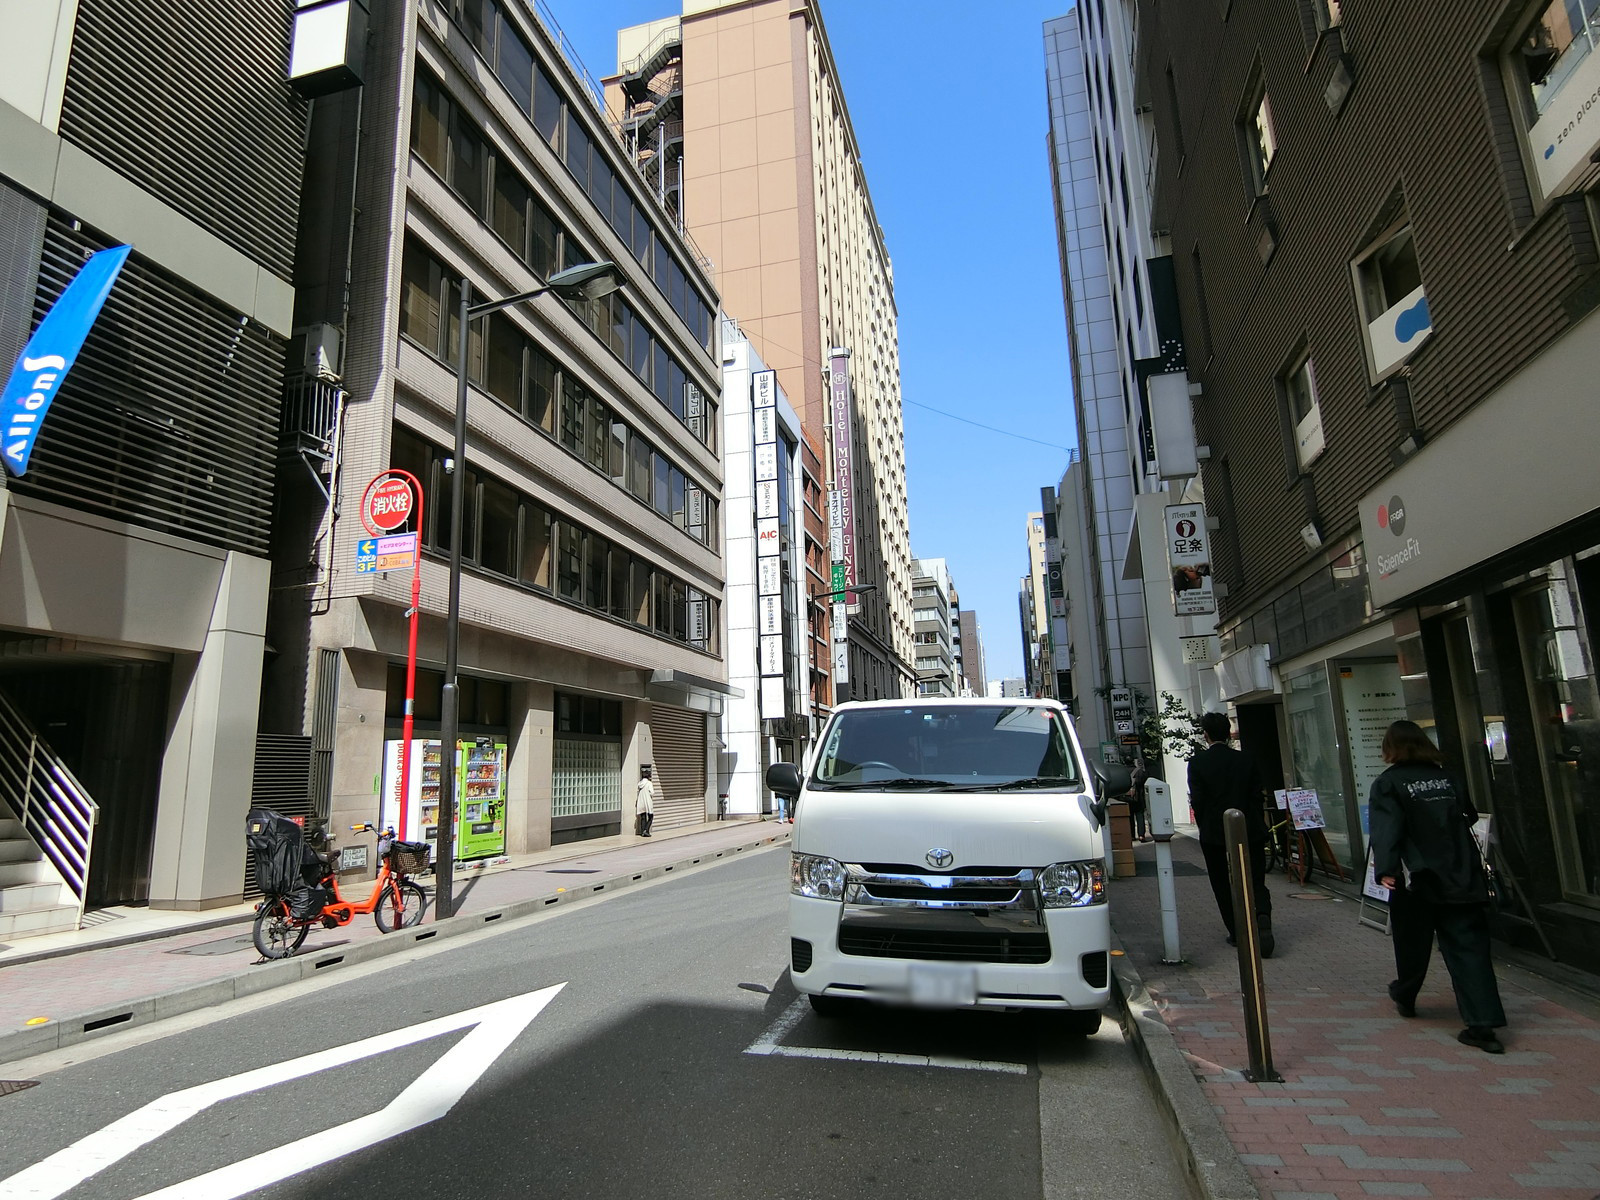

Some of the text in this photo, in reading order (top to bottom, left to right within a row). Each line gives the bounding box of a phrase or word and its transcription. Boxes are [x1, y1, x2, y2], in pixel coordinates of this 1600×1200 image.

[1557, 121, 1575, 144] zen
[759, 374, 769, 404] 山岸ビル
[836, 390, 846, 442] Hotel
[838, 447, 850, 529] Monterey
[373, 492, 409, 516] 消火栓
[760, 530, 777, 540] AIC
[1174, 538, 1203, 554] 足楽
[357, 554, 377, 563] このビル
[357, 562, 376, 572] 3F
[843, 535, 853, 587] GINZA
[1377, 537, 1421, 575] ScienceFit
[1112, 693, 1129, 702] NPC
